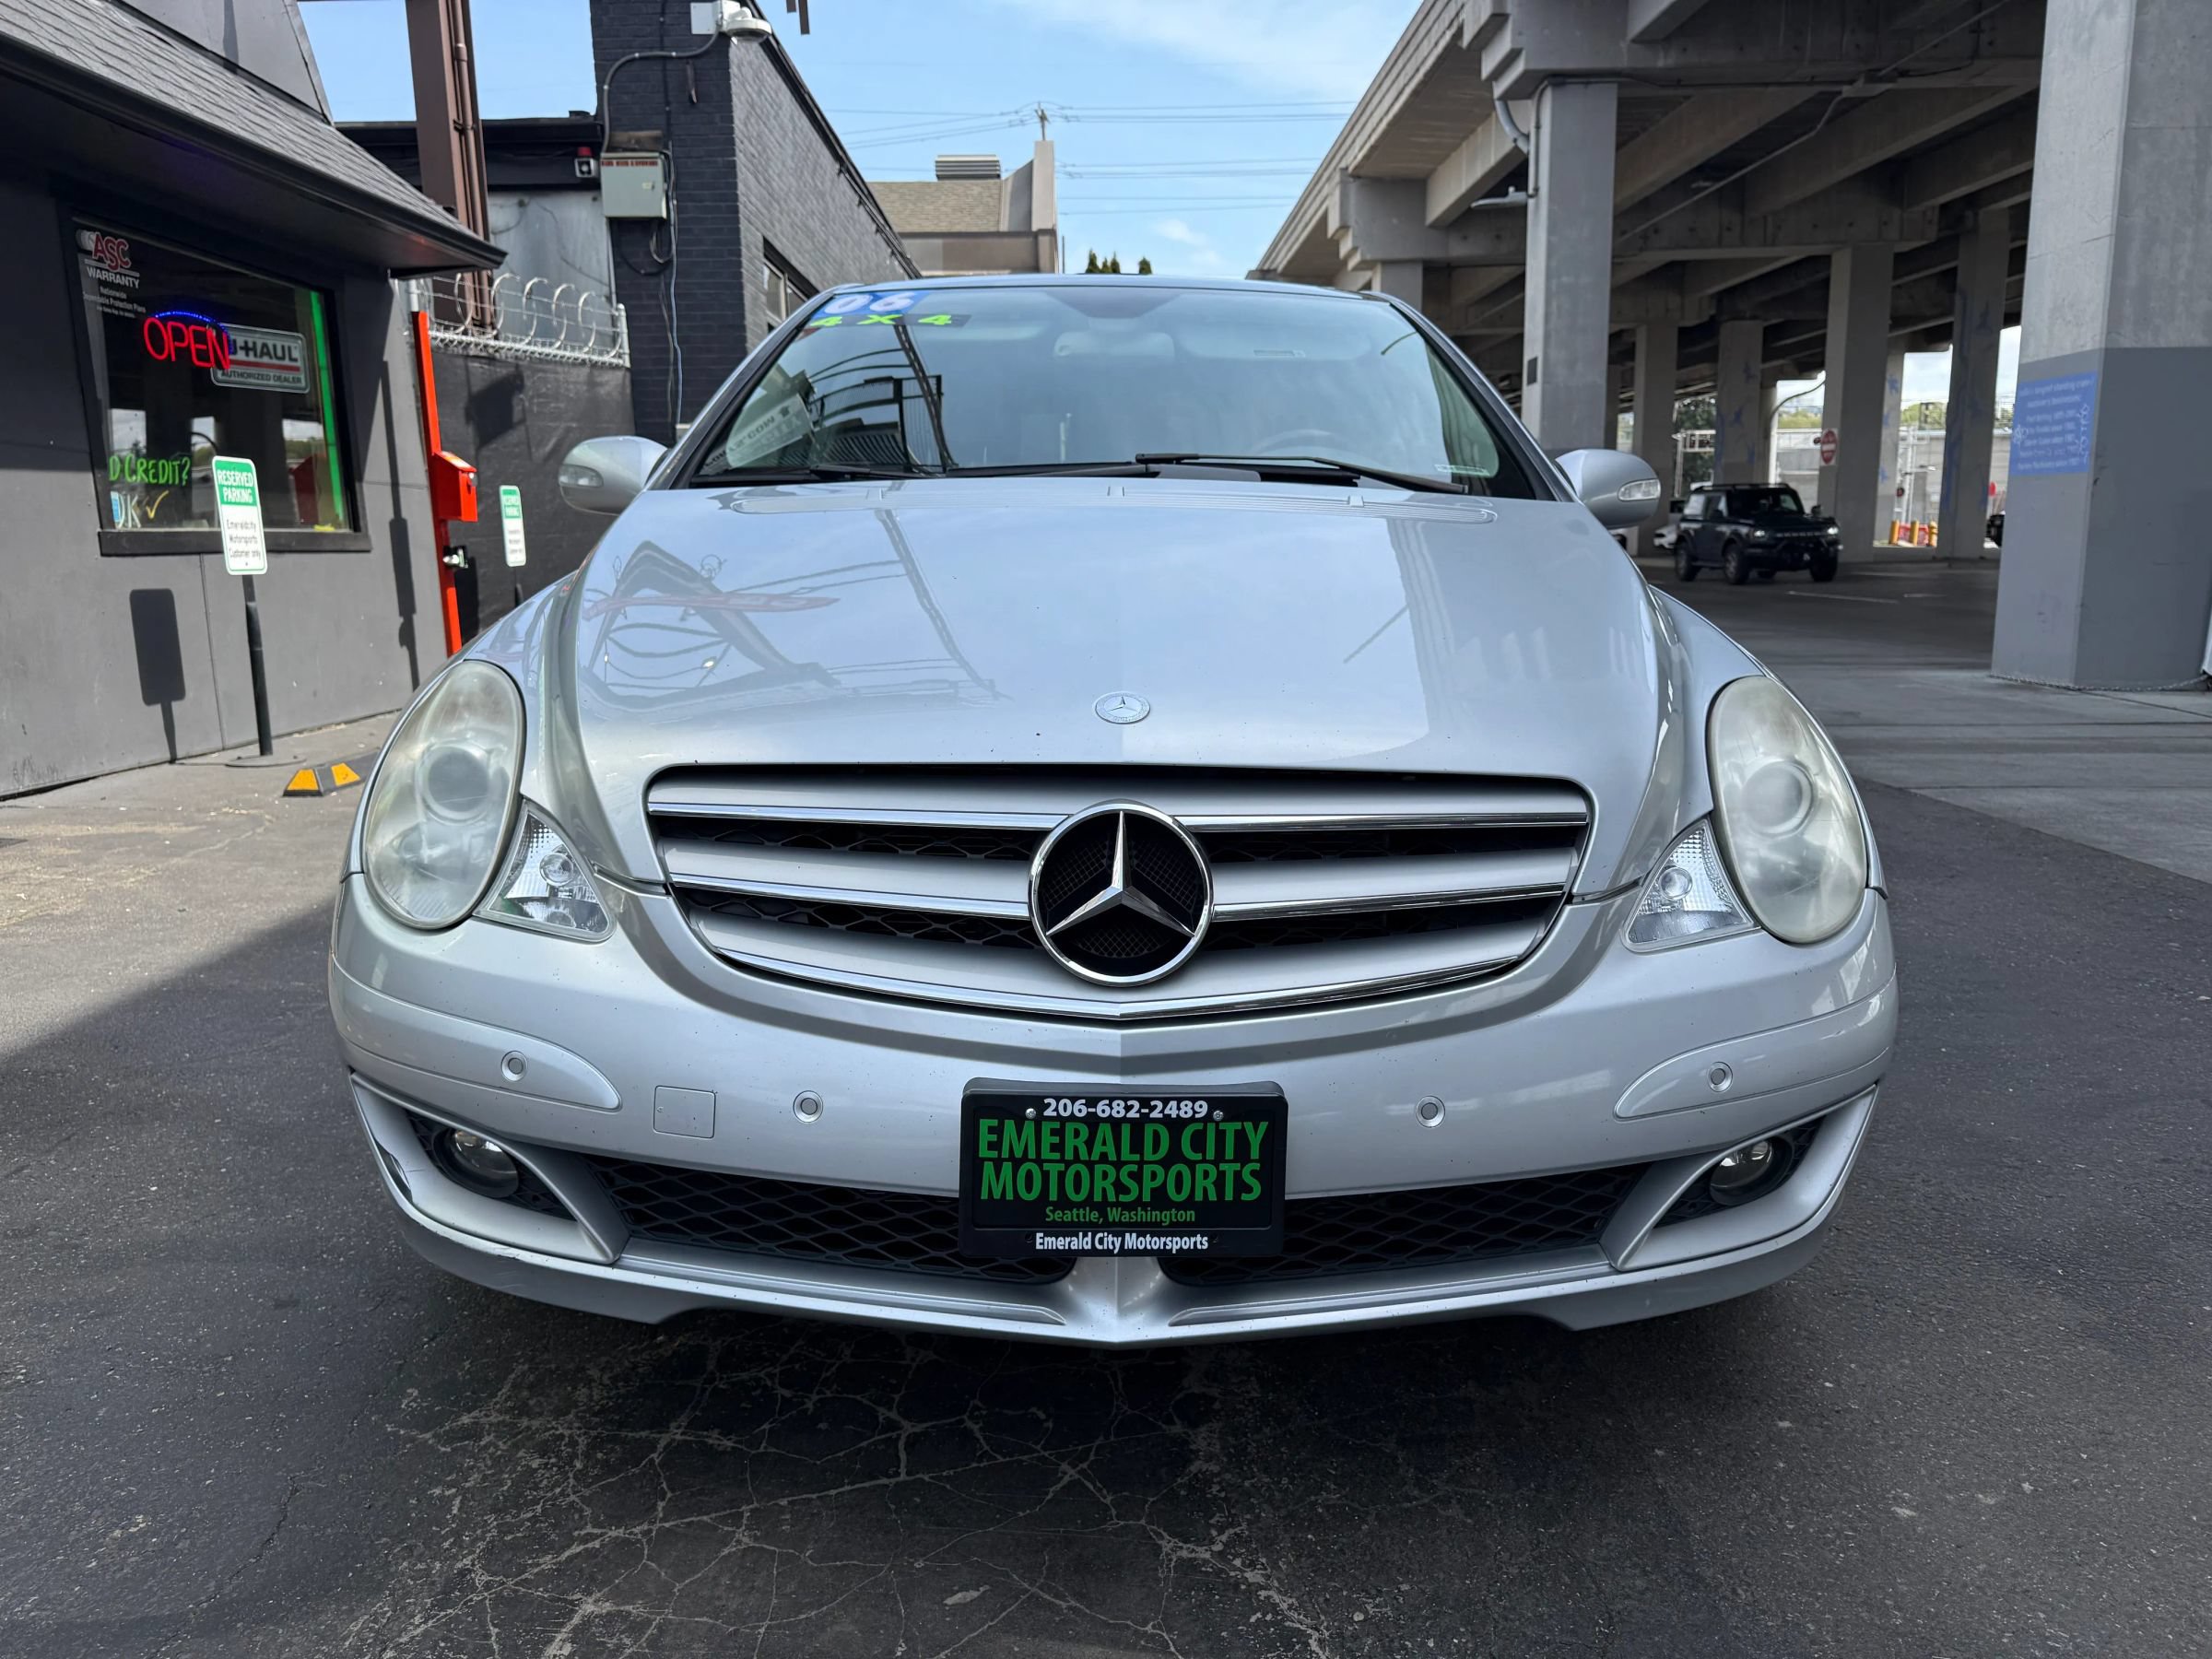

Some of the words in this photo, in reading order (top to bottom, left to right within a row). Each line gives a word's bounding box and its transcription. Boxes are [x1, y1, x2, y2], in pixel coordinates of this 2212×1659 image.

[92, 231, 131, 271] ASC
[87, 266, 140, 288] WARRANTY
[824, 292, 916, 314] 06
[144, 317, 229, 371] OPEN
[221, 371, 272, 382] AUTHORIZED
[273, 374, 302, 384] DEALER
[124, 453, 191, 487] CREDIT?
[217, 469, 254, 488] RESERVED
[223, 487, 253, 503] PARKING
[1043, 1098, 1208, 1119] 206-682-2489
[978, 1119, 1171, 1161] EMERALD
[1181, 1121, 1268, 1160] CITY
[980, 1161, 1262, 1202] MOTORSPORTS
[1045, 1206, 1104, 1224] Seattle,
[1107, 1207, 1196, 1226] Washington
[1035, 1232, 1092, 1250] Emerald
[1095, 1233, 1122, 1254] City
[1124, 1232, 1208, 1253] Motorsports
